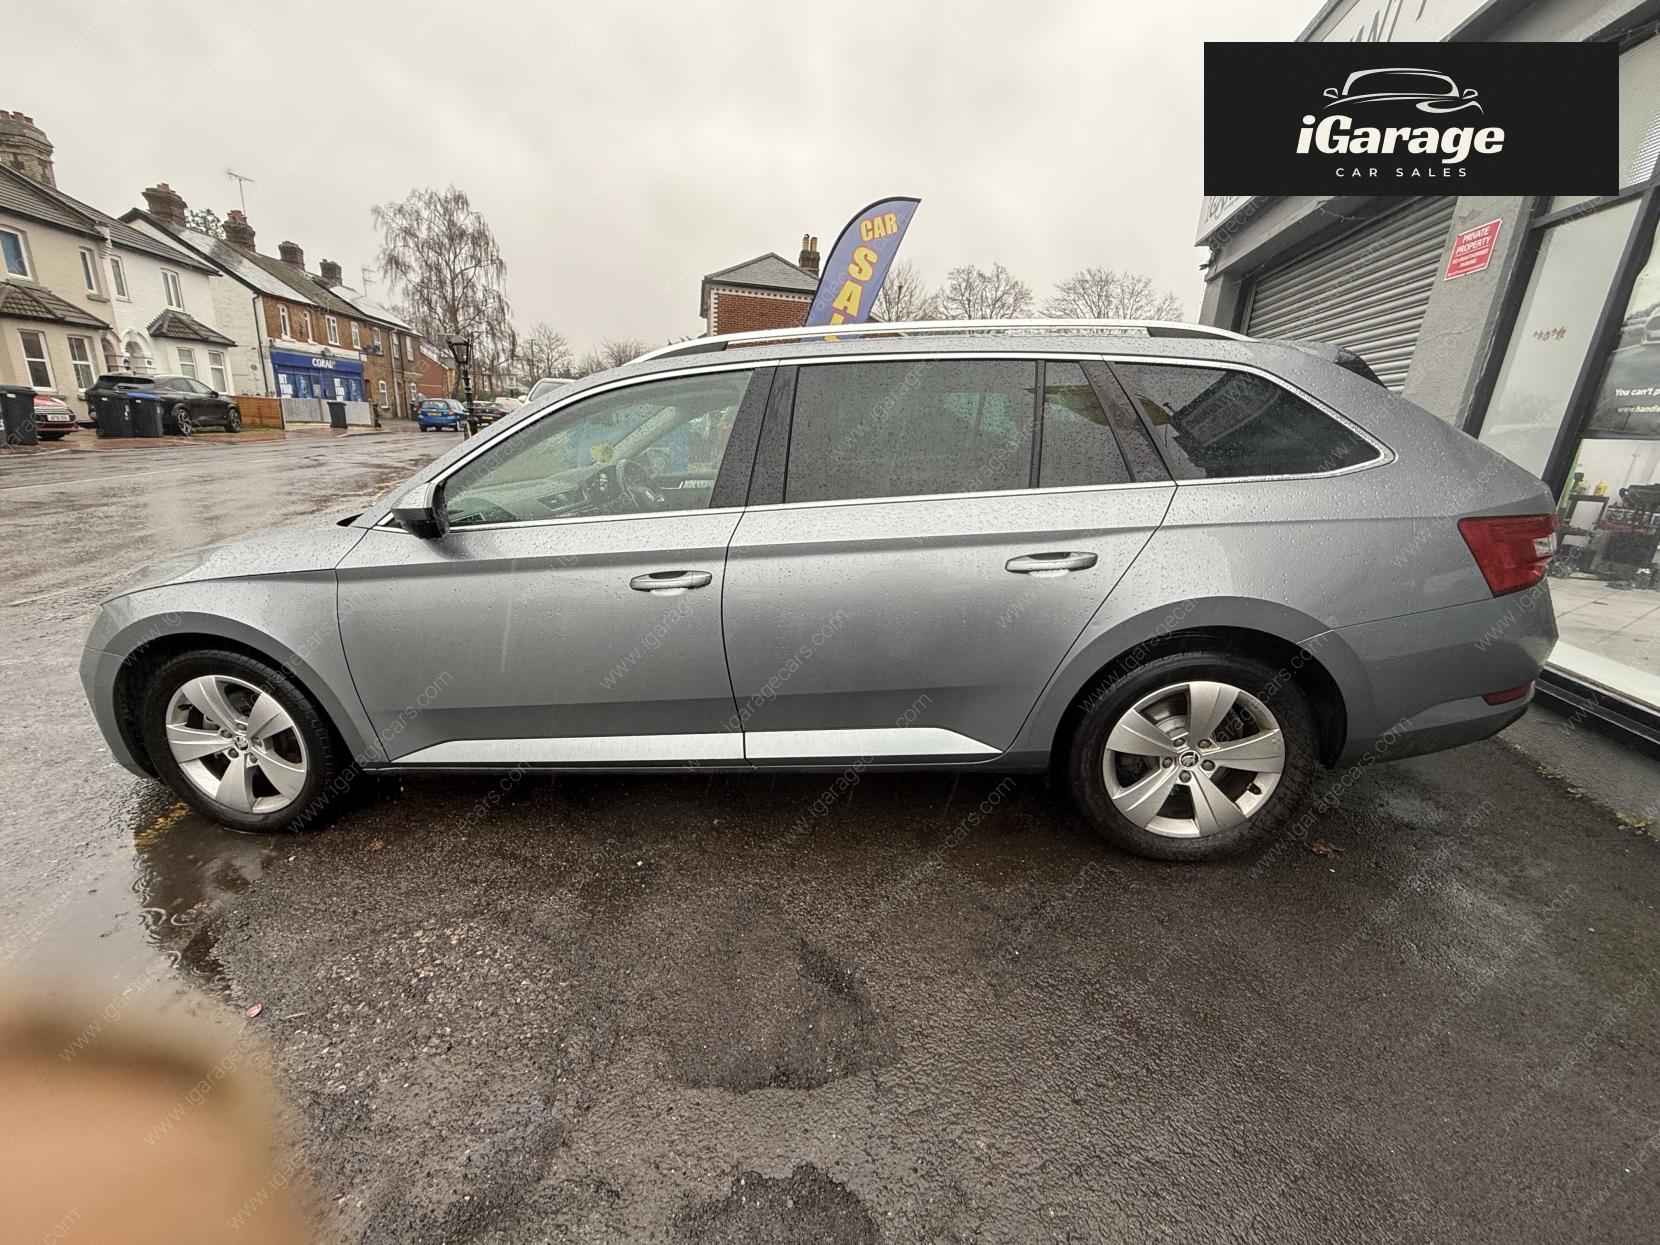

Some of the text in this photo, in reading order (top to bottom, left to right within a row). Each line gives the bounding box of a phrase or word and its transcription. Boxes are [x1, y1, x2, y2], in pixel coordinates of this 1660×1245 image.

[860, 213, 898, 241] CAR
[1462, 227, 1490, 243] PRIVATE
[1455, 235, 1492, 254] PROPERTY
[311, 358, 334, 368] CORAL
[1615, 388, 1630, 396] You
[1631, 387, 1653, 396] can't
